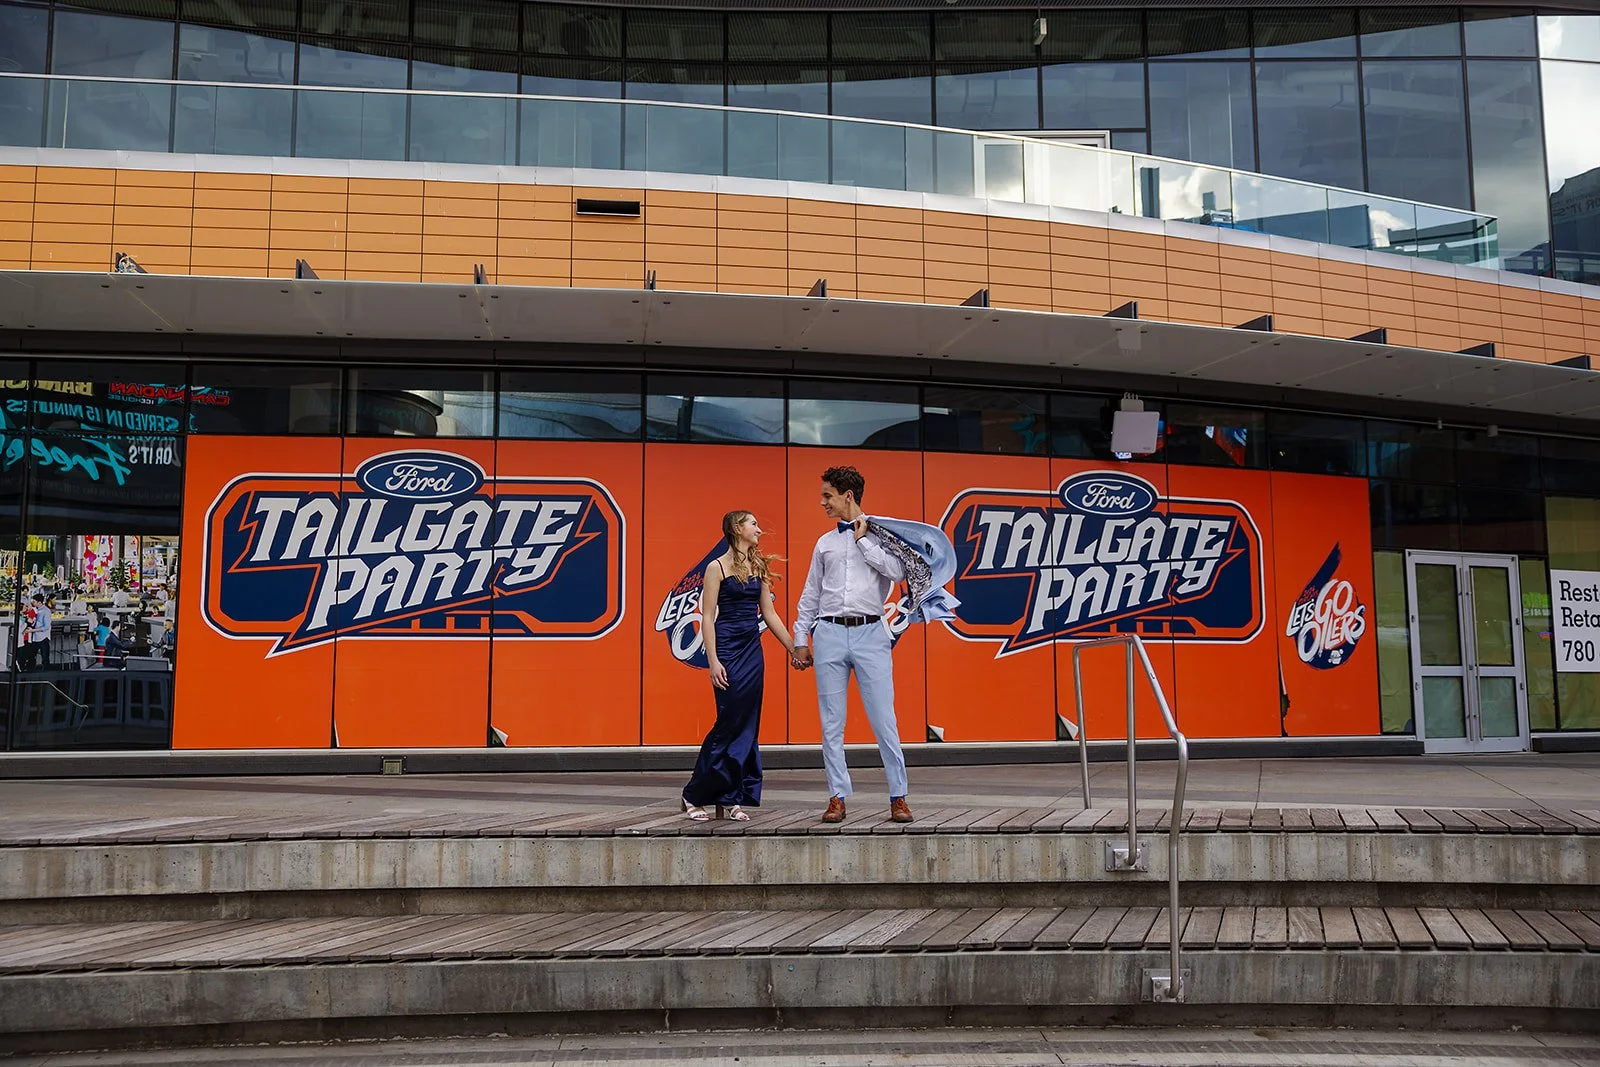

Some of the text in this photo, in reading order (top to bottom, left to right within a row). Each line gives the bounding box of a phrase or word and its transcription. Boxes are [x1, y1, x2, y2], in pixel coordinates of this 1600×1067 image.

[386, 463, 455, 493] Ford
[1081, 483, 1135, 509] Ford
[250, 497, 582, 561] TAILGATE
[977, 510, 1230, 570] TAILGATE
[306, 544, 563, 631] PARTY
[1026, 558, 1219, 634] PARTY
[1315, 579, 1353, 624] GO
[1297, 605, 1366, 662] OILERS
[1563, 640, 1595, 661] 780
